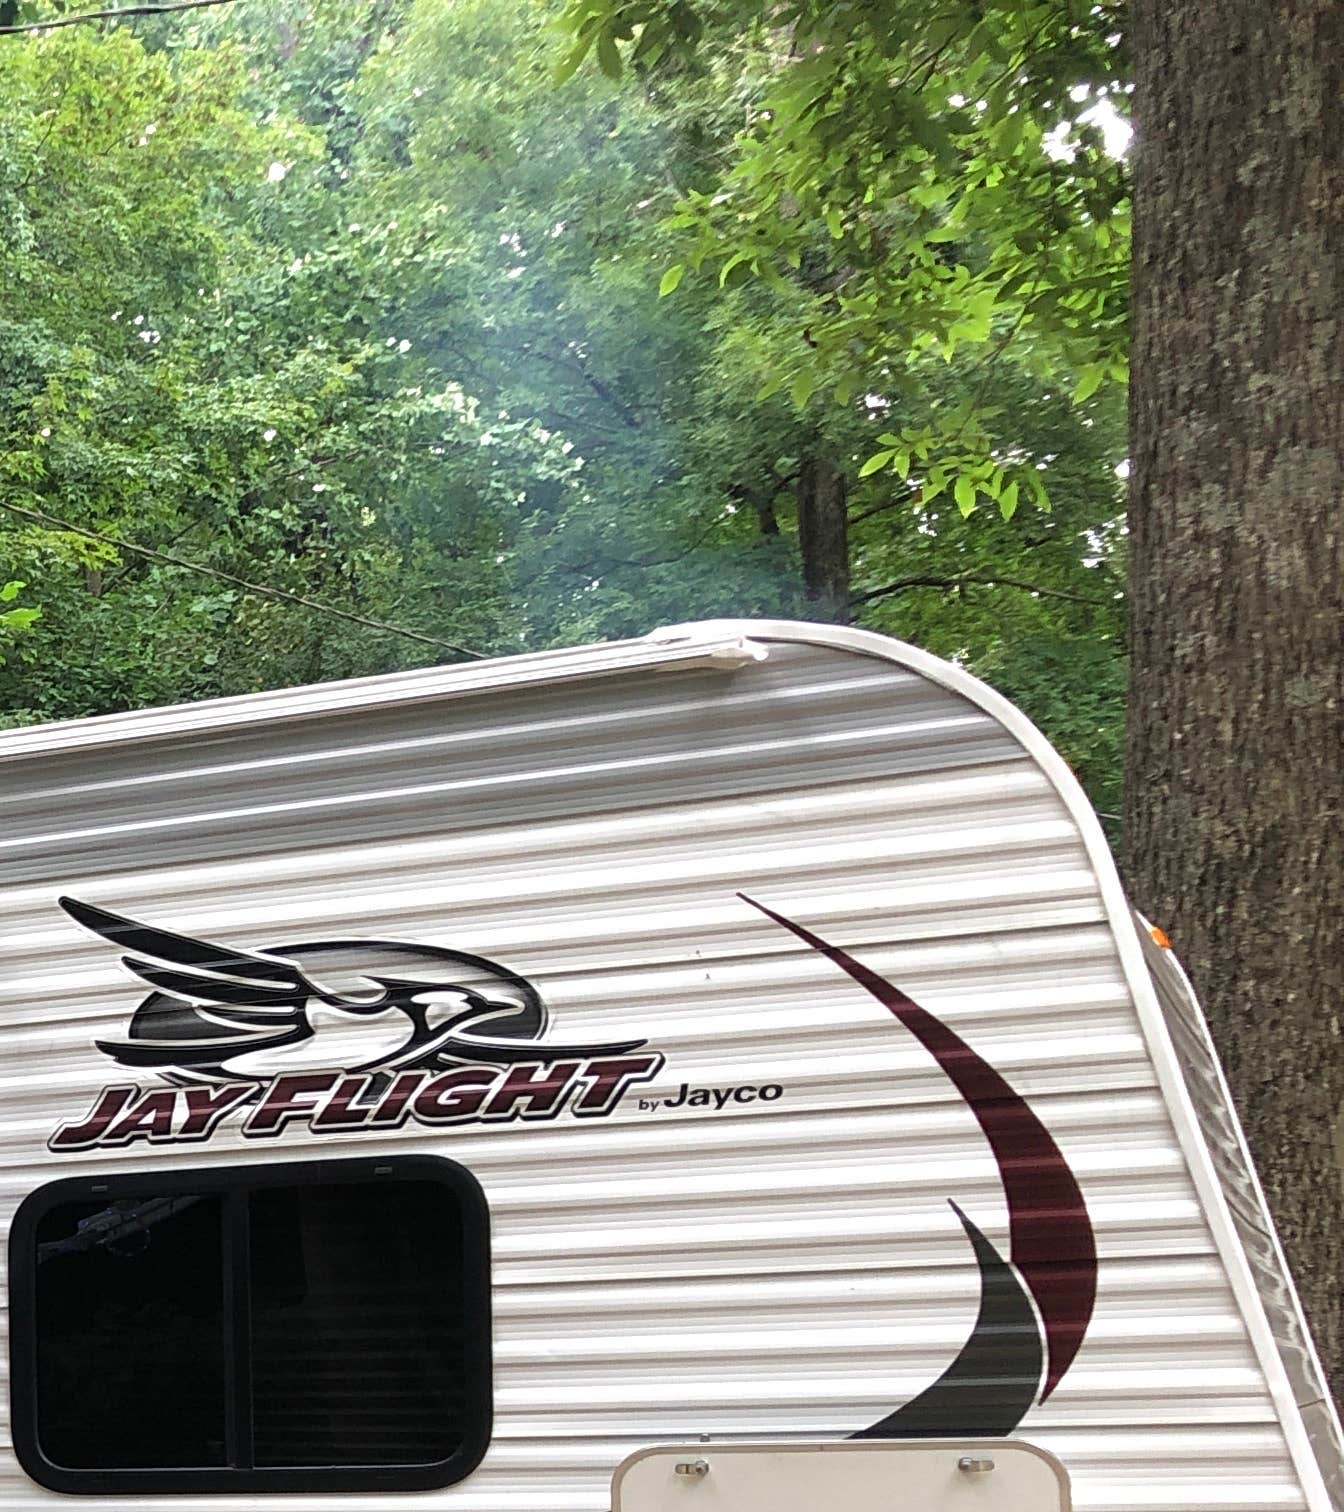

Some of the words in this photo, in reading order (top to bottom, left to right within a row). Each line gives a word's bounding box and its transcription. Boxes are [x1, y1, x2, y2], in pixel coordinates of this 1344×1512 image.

[48, 1083, 261, 1152] JAY
[242, 1053, 665, 1138] FLIGHT
[638, 1099, 660, 1112] by
[663, 1083, 784, 1111] Jayco
